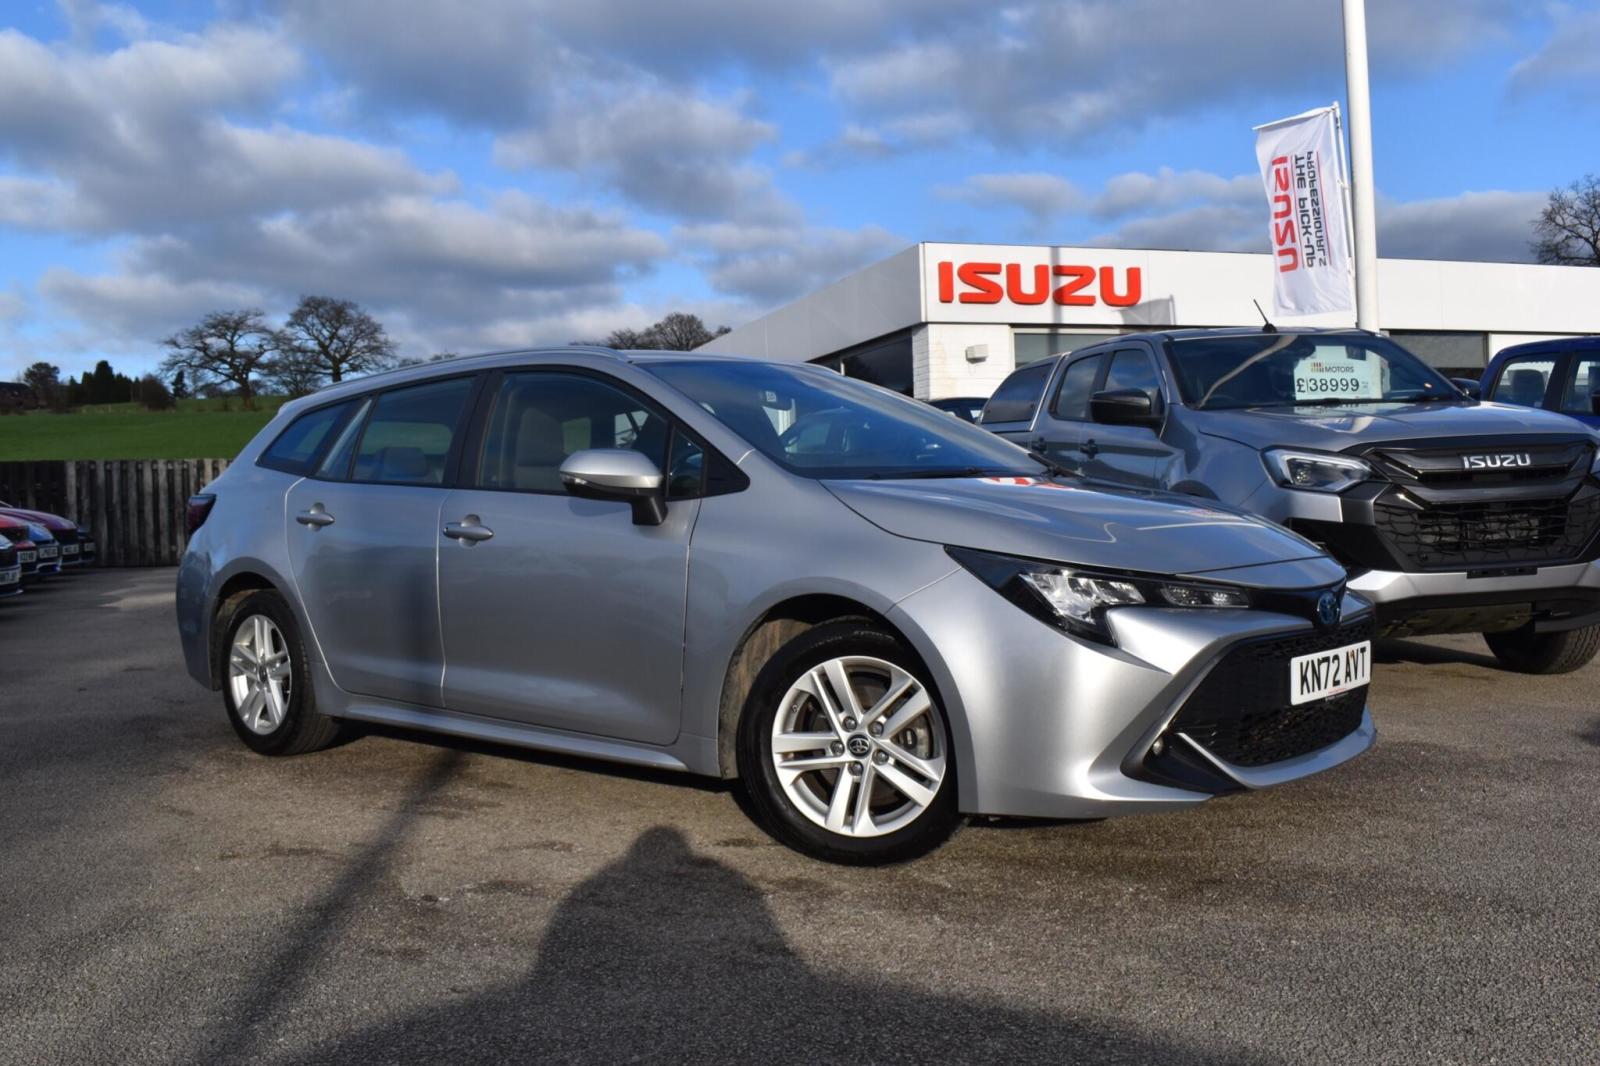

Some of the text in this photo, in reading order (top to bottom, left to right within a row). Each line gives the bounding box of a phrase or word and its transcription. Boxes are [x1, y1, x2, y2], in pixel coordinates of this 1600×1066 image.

[938, 261, 1142, 308] ISUZU
[1325, 366, 1355, 374] MOTORS
[1296, 377, 1360, 393] £38999
[1463, 453, 1532, 469] ISUZU
[1300, 653, 1341, 696] KN72
